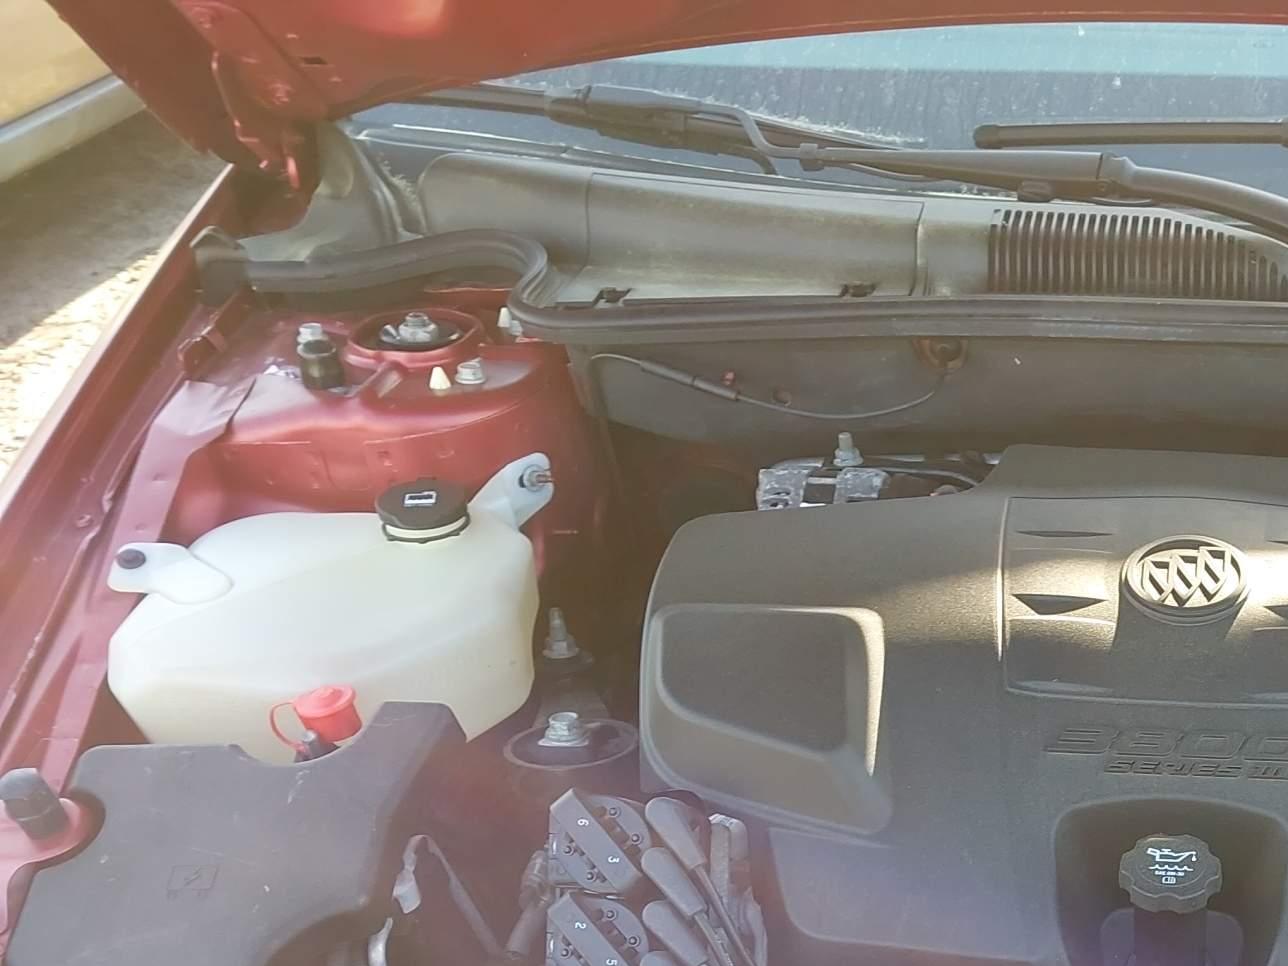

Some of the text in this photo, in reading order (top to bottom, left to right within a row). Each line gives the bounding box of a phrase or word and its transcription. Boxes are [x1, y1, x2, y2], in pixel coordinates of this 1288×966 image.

[1104, 760, 1242, 779] SERIES
[577, 818, 589, 827] 6
[607, 855, 620, 864] 3
[574, 921, 587, 930] 2
[605, 957, 618, 966] 5
